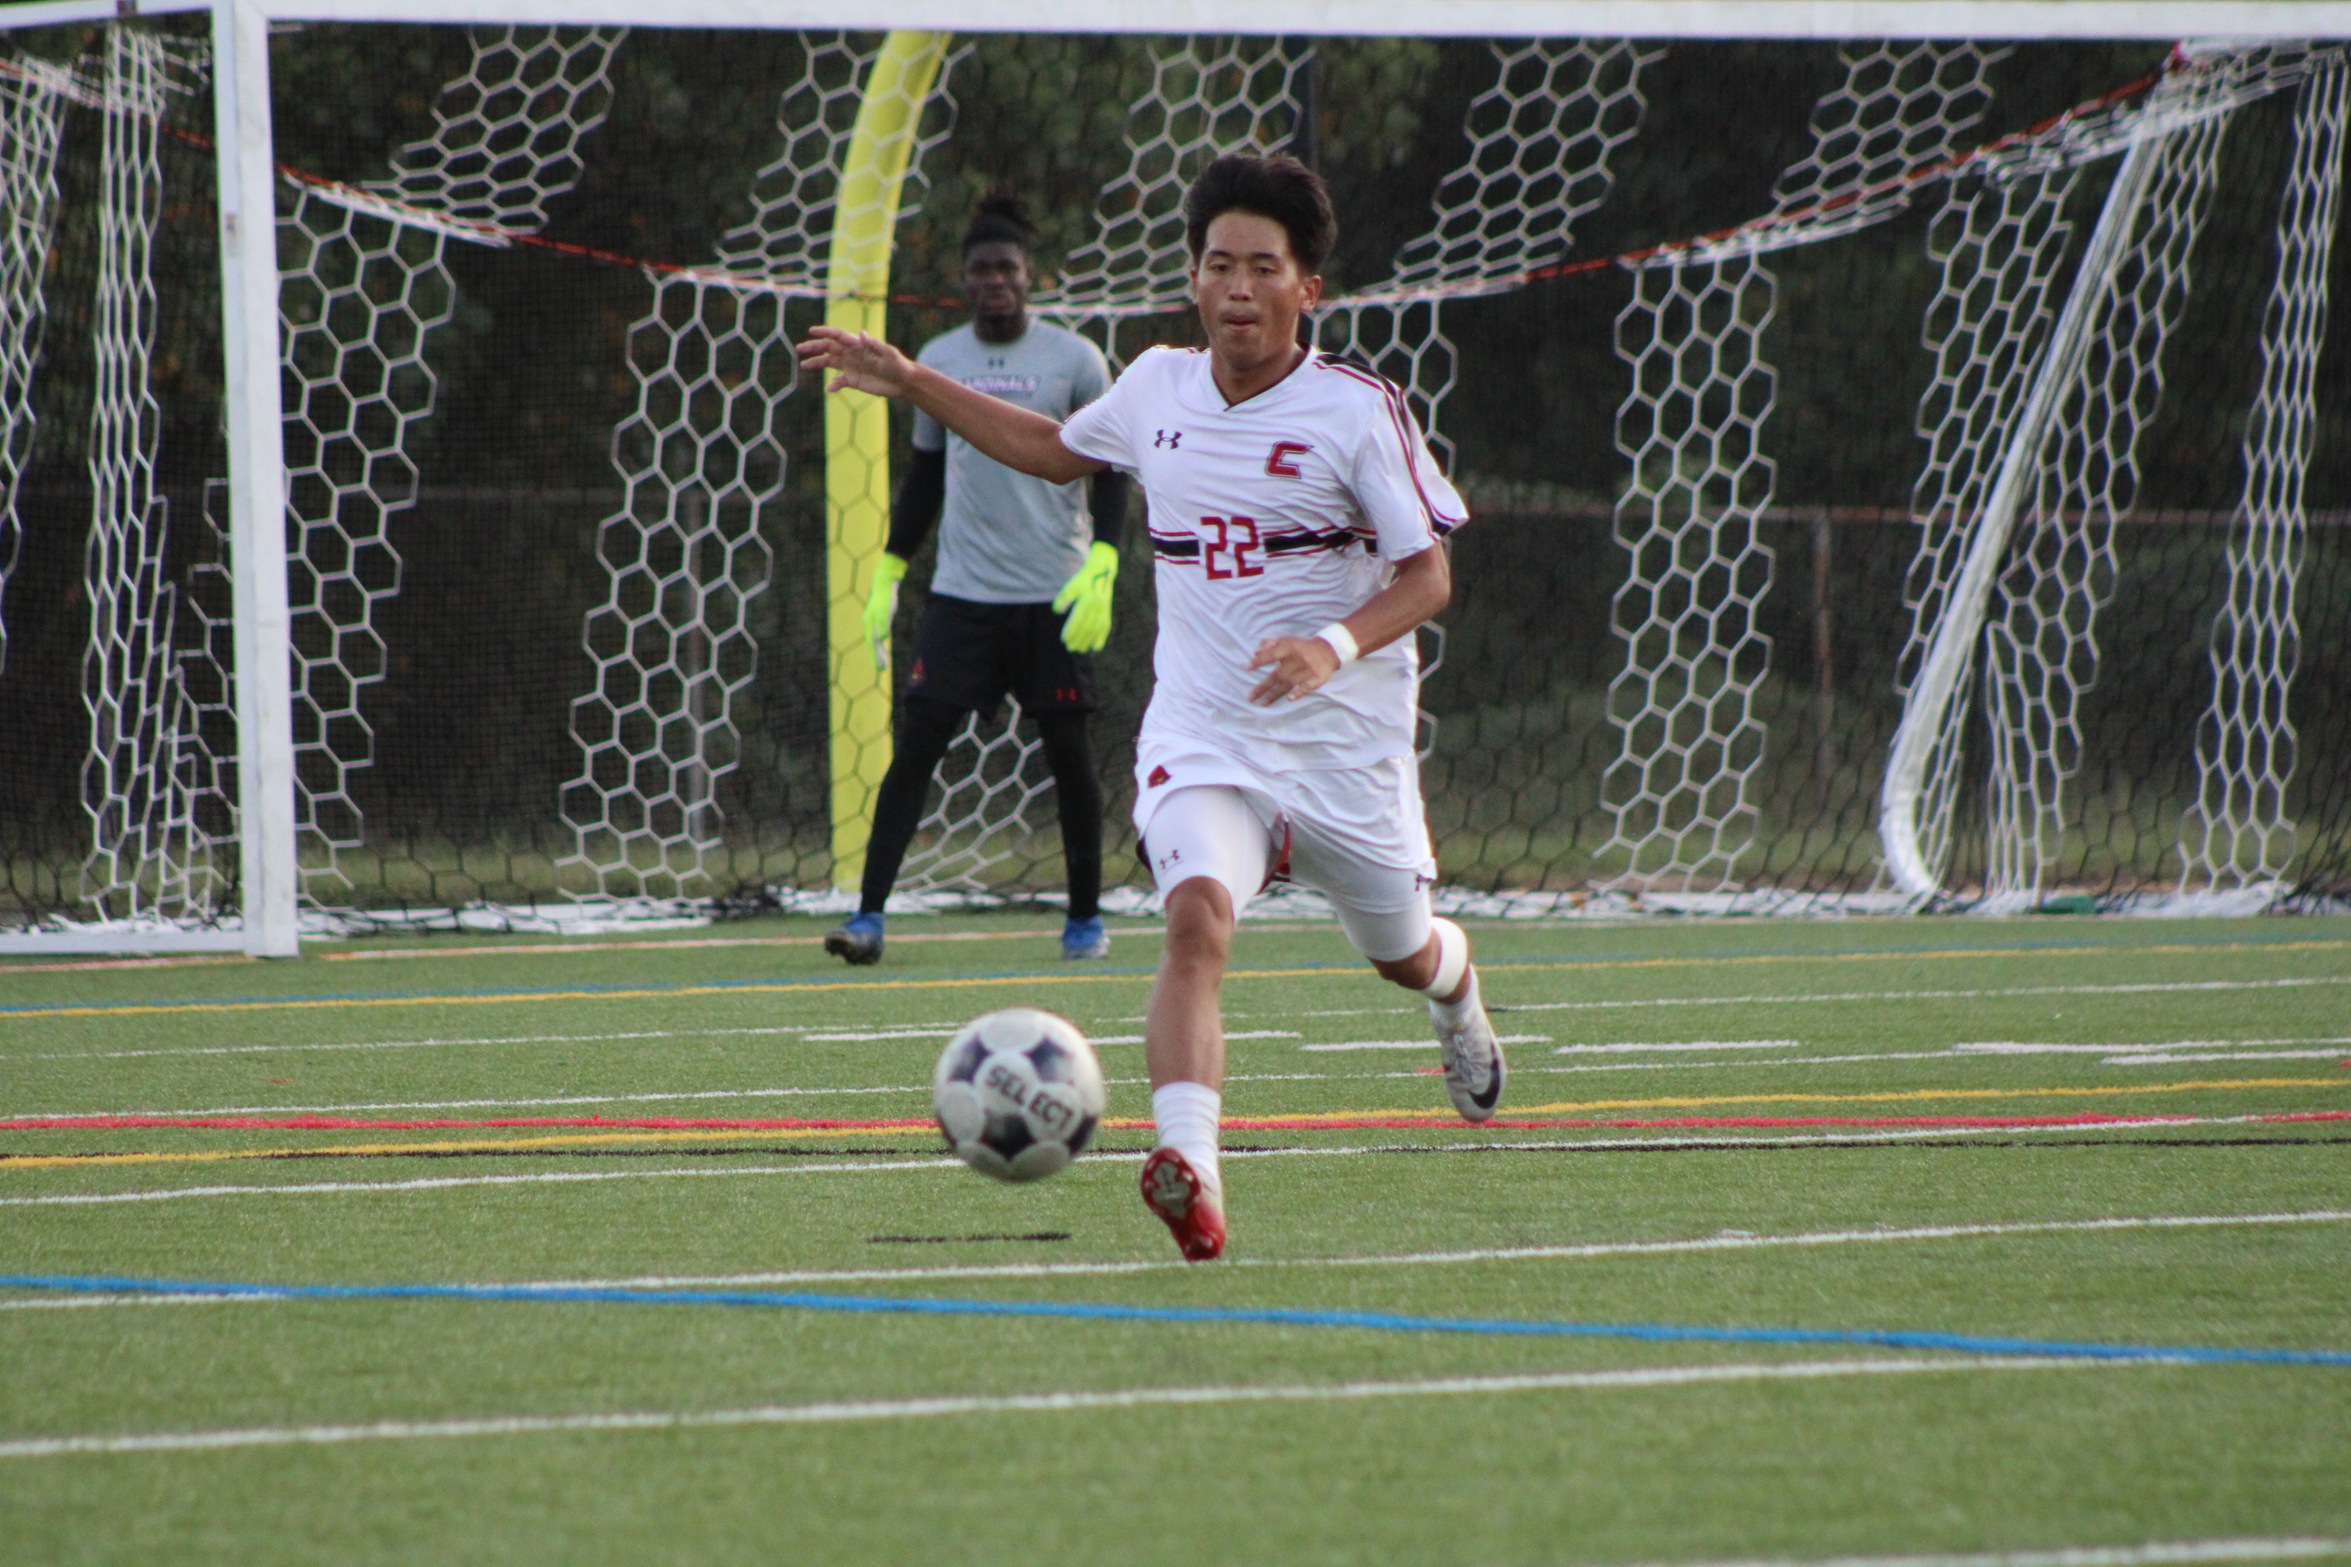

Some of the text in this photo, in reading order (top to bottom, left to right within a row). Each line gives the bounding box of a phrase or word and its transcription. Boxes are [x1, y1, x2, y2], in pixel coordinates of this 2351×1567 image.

[1265, 441, 1315, 479] C
[1200, 516, 1264, 580] 22
[986, 1066, 1074, 1131] SELECT
